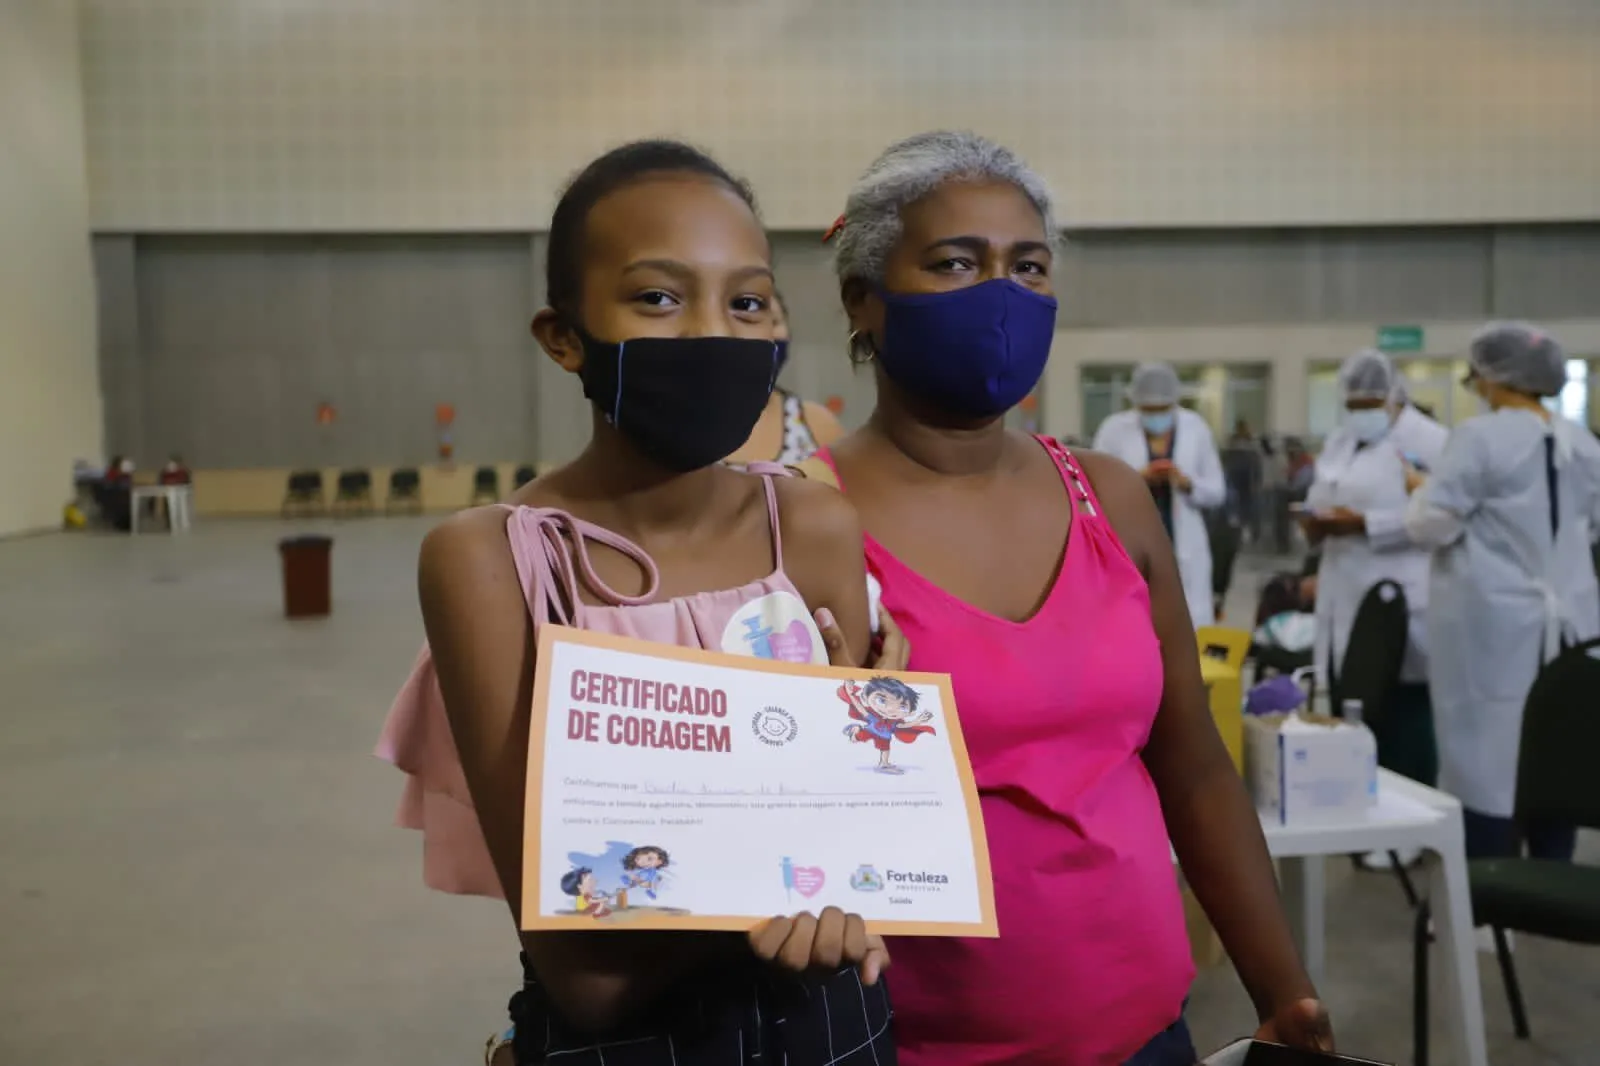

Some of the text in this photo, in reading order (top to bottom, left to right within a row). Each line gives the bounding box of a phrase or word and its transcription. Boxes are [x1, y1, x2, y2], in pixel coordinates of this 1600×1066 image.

[570, 669, 728, 718] CERTIFICADO
[567, 708, 732, 752] DE CORAGEM
[886, 869, 949, 884] Fortaleza
